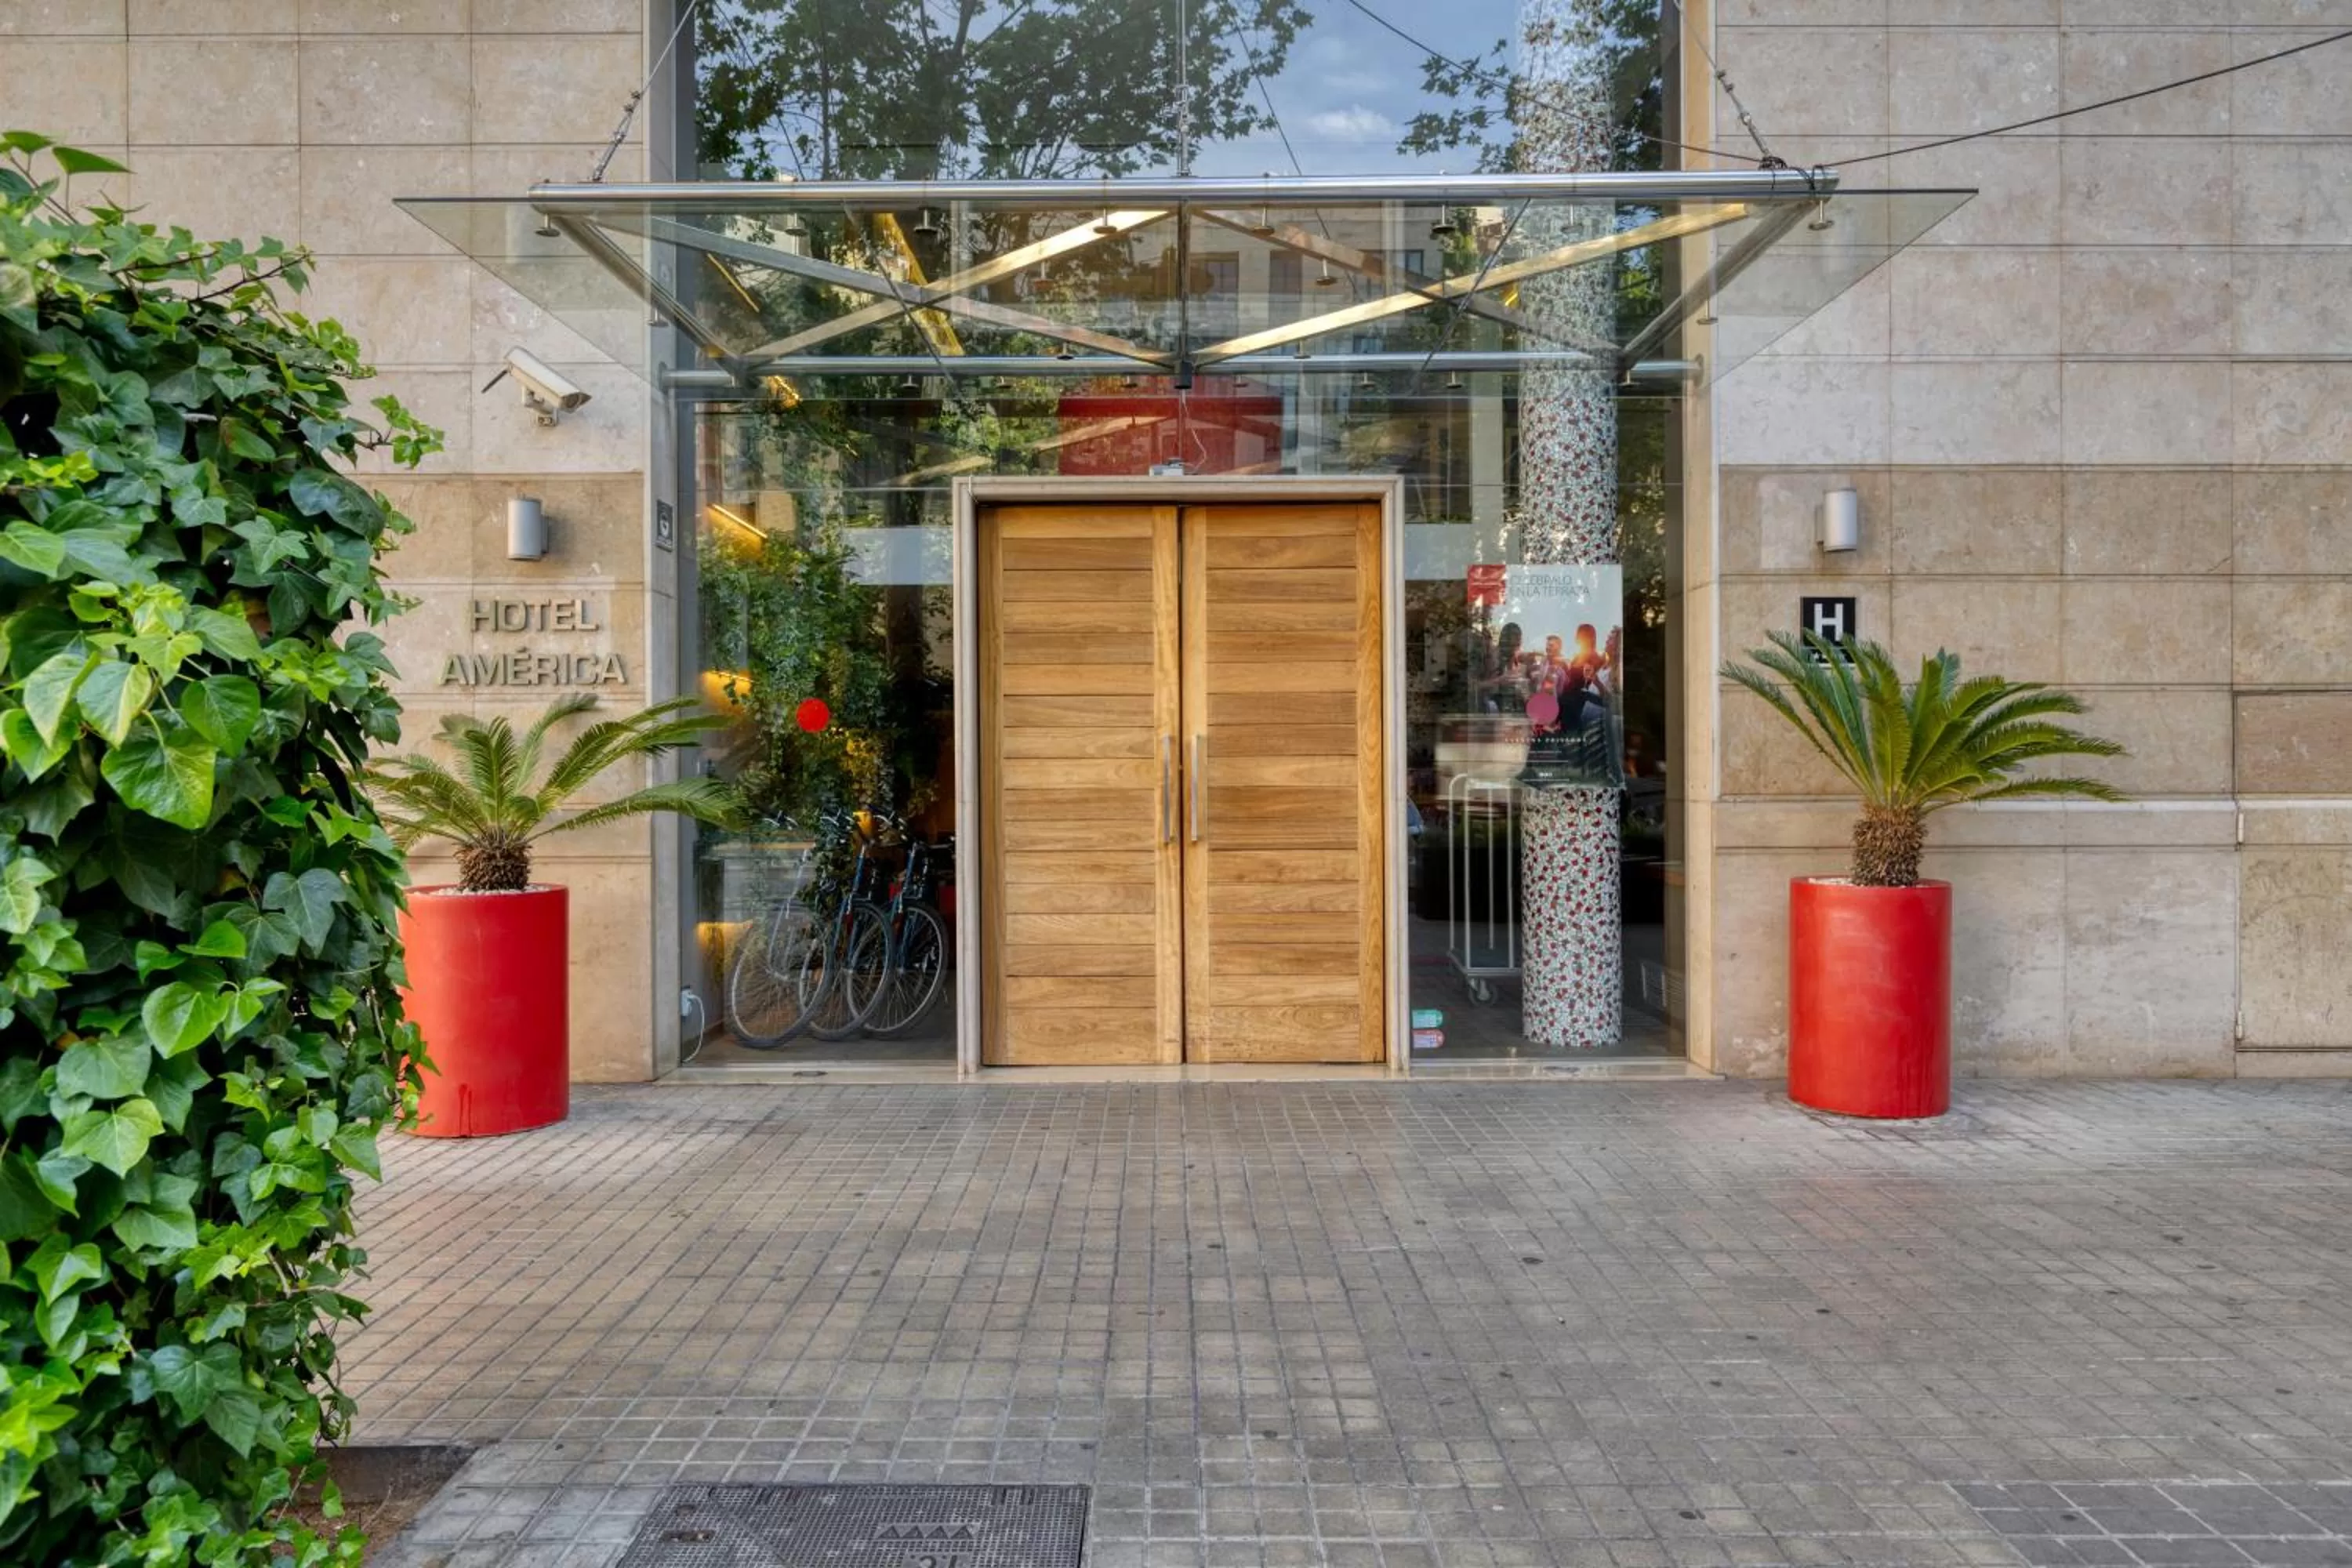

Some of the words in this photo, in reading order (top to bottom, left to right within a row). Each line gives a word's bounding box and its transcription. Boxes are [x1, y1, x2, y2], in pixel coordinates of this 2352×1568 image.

[470, 599, 599, 632] HOTEL
[1813, 603, 1844, 641] H
[440, 647, 627, 685] AMÉRICA
